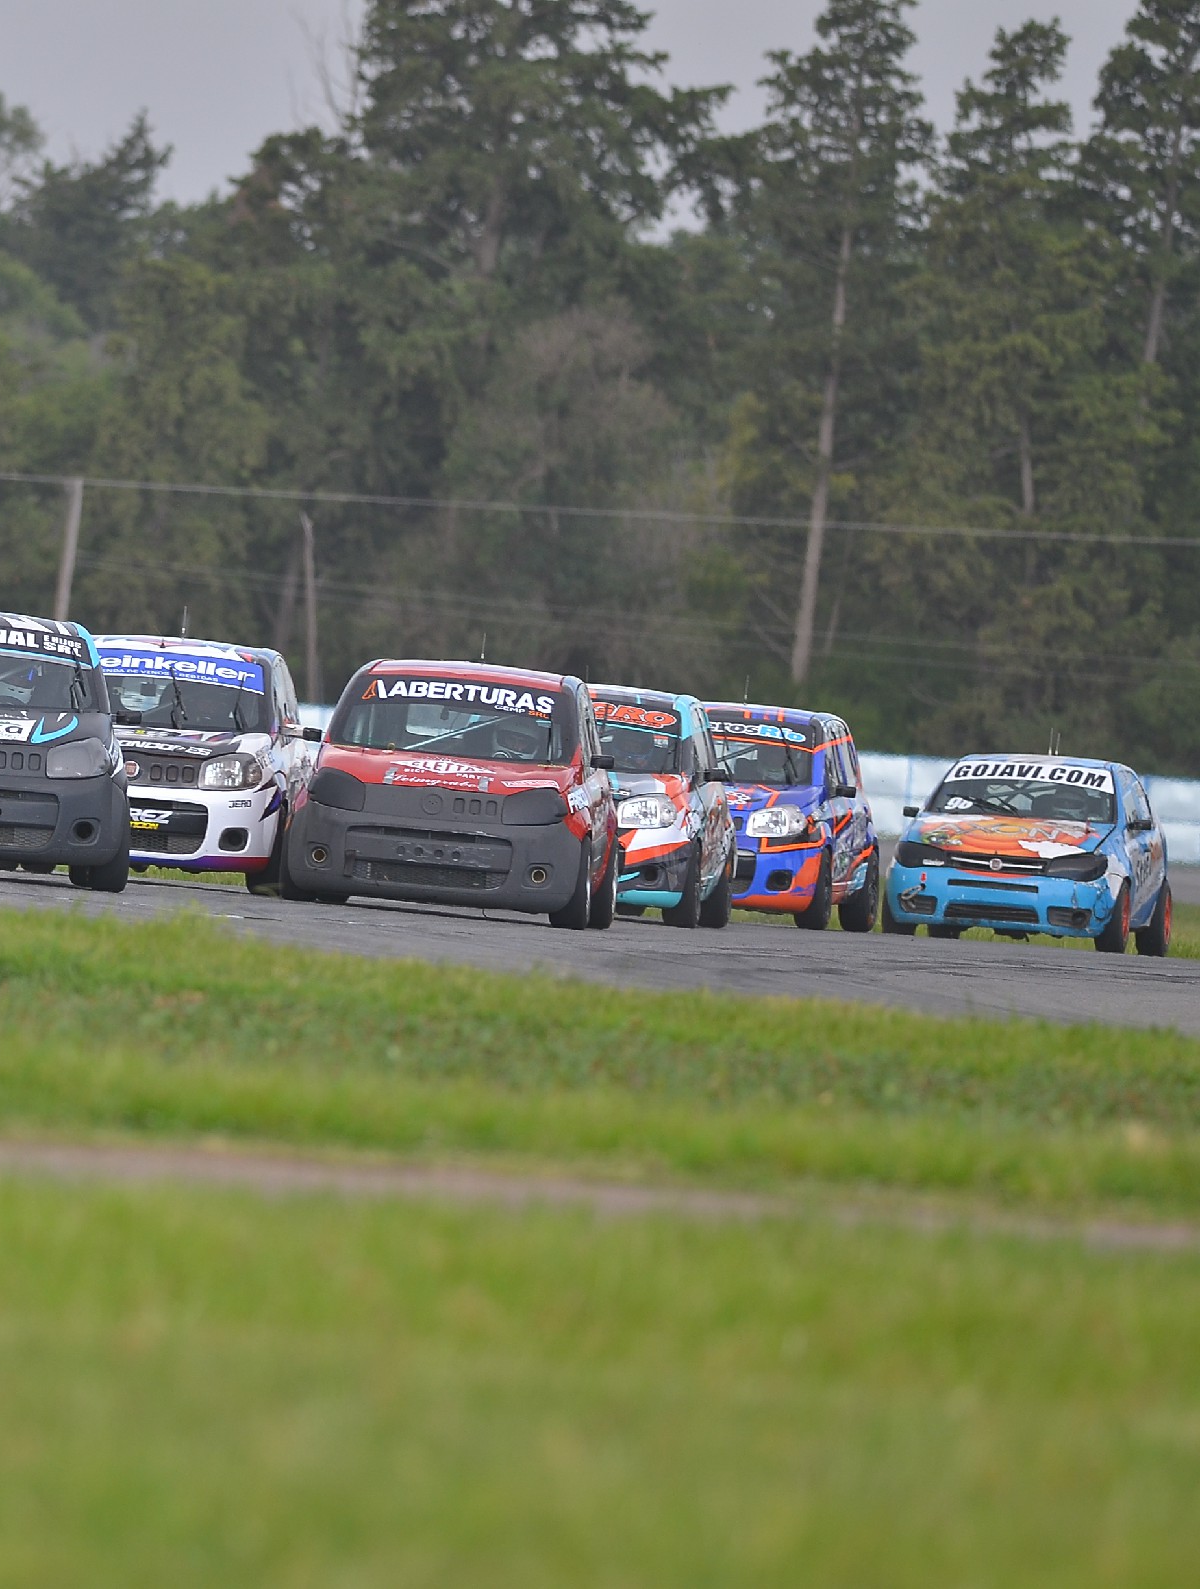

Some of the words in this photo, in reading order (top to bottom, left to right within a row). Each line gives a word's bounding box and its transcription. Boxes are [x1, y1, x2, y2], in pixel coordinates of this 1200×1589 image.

[43, 641, 82, 659] SRL
[99, 654, 256, 682] einkeller
[387, 680, 555, 713] ABERTURAS
[528, 710, 550, 720] SRL
[954, 763, 1108, 788] GOJAVI.COM
[129, 807, 175, 824] REZ
